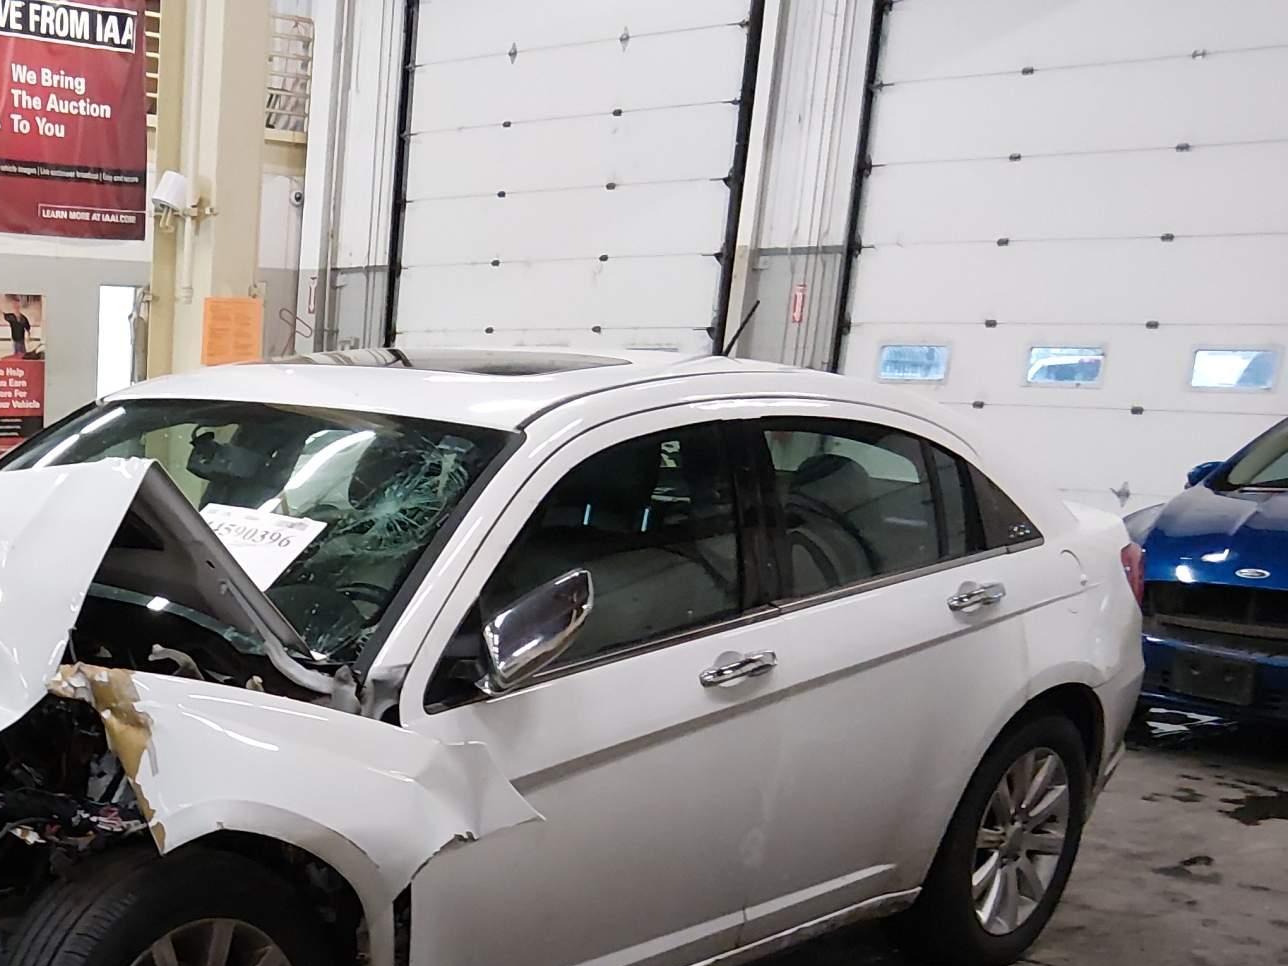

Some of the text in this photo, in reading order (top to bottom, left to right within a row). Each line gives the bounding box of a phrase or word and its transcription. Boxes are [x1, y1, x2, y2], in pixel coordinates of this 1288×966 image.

[29, 4, 90, 40] FROM
[96, 17, 134, 45] IAA
[11, 64, 86, 94] We Bring
[10, 89, 111, 118] The Auction
[10, 114, 65, 138] To You
[42, 209, 67, 219] LEARN
[92, 212, 101, 221] AT
[6, 367, 24, 378] Help
[8, 378, 27, 387] Earn
[14, 389, 27, 398] For
[12, 399, 40, 408] Vehicle
[209, 521, 295, 547] 4590396
